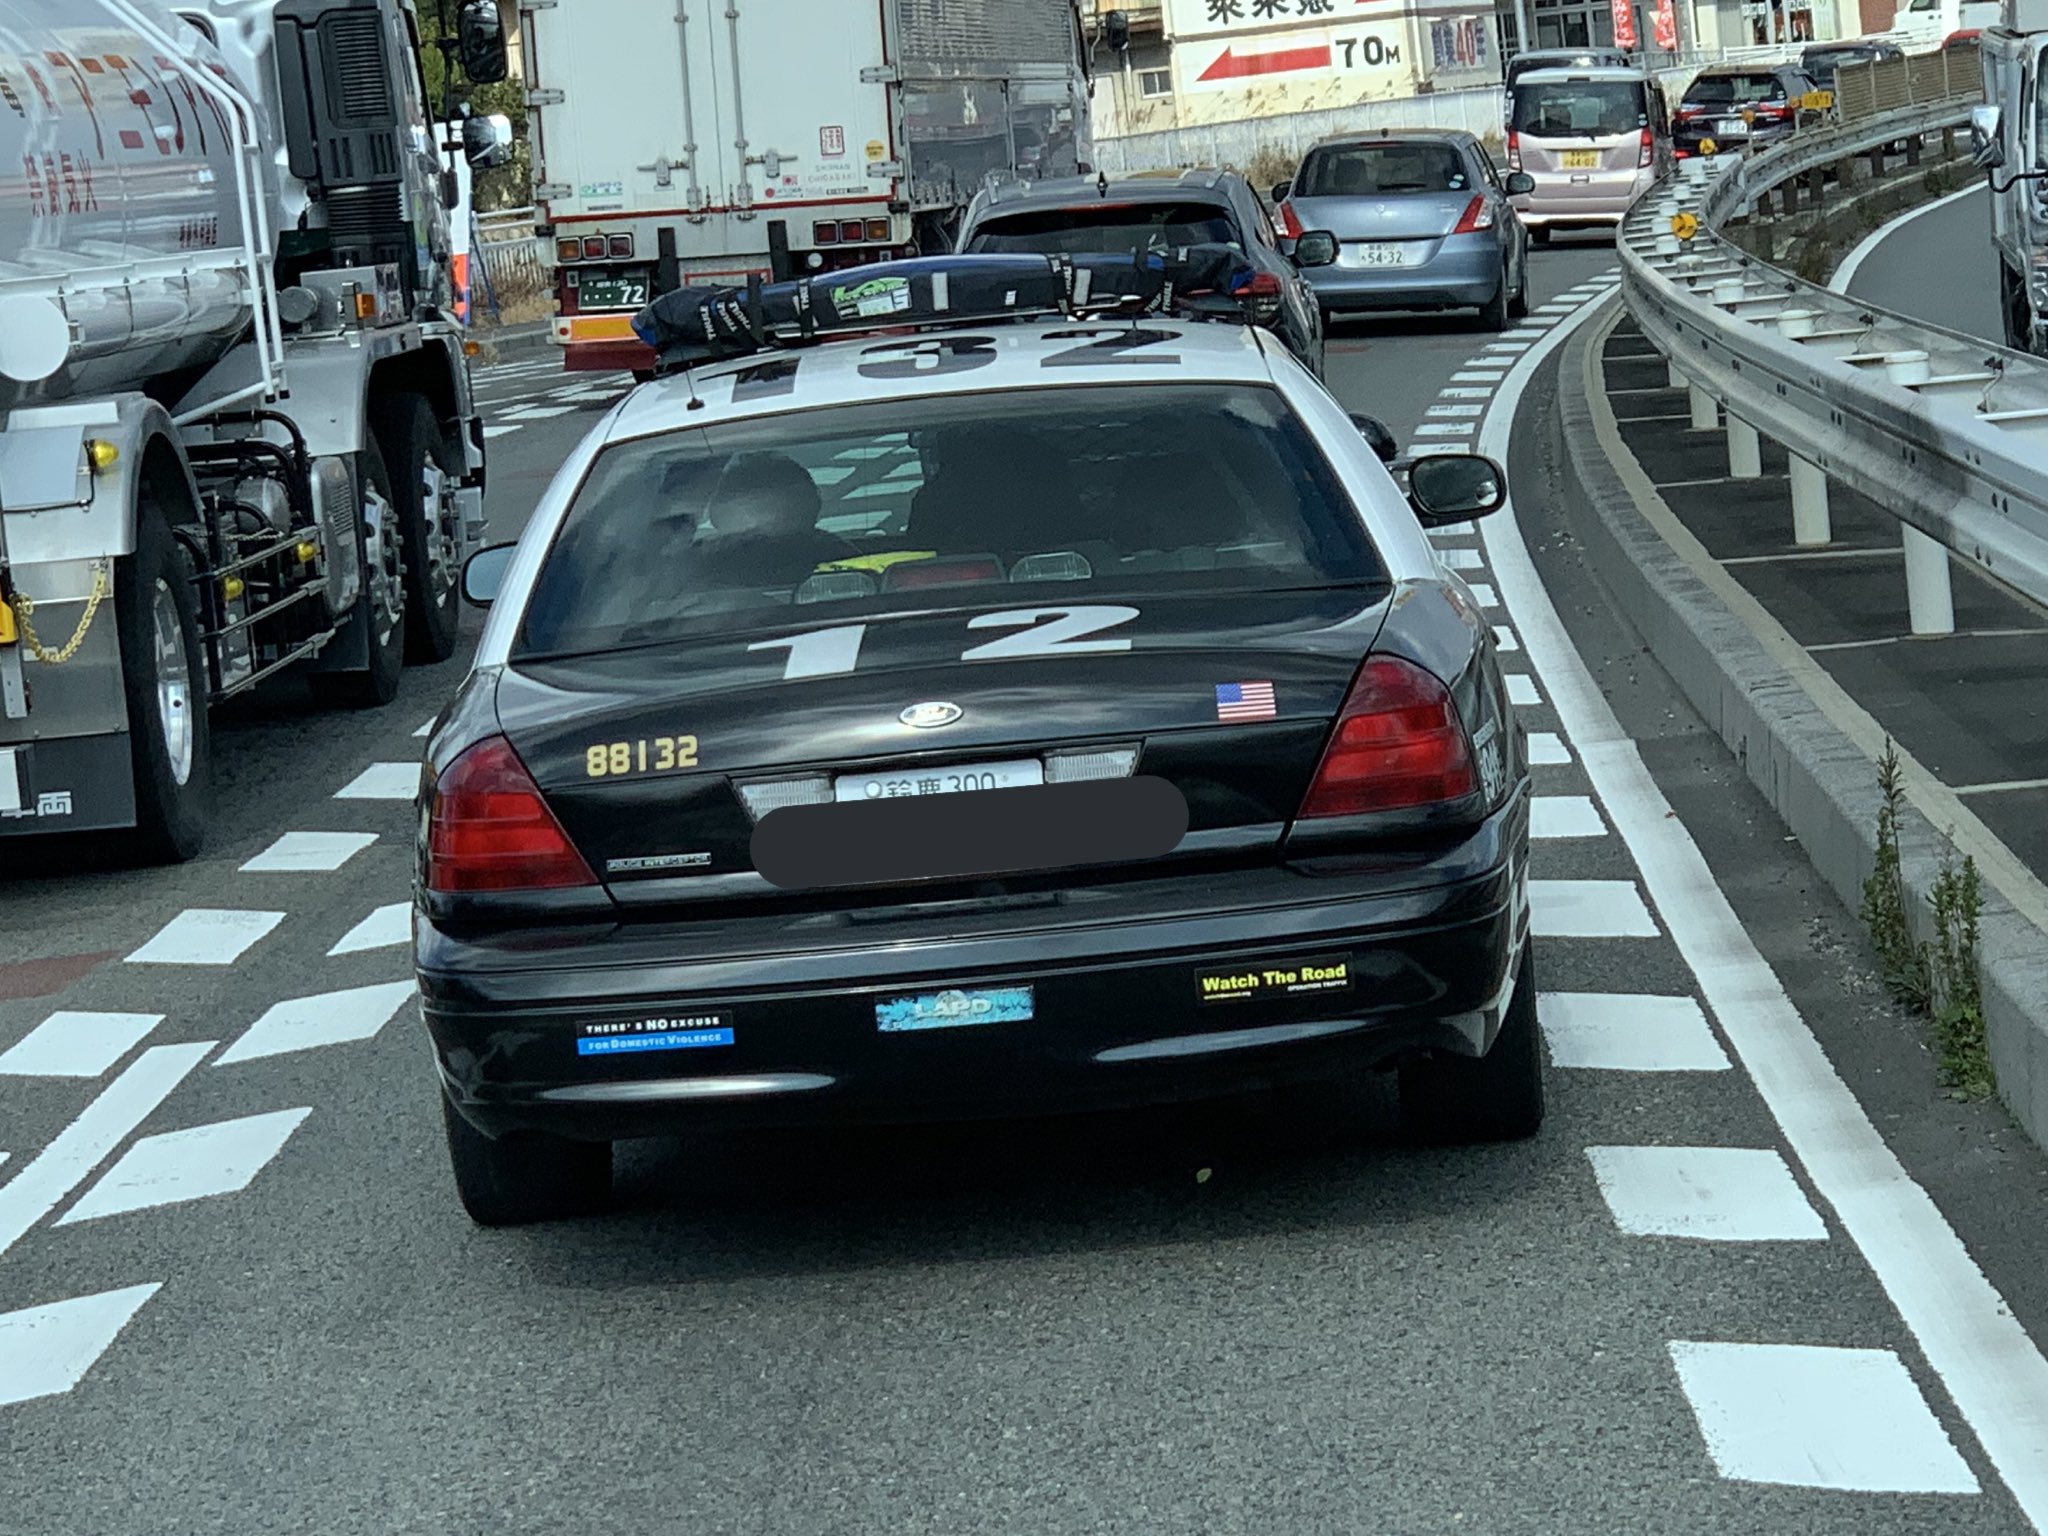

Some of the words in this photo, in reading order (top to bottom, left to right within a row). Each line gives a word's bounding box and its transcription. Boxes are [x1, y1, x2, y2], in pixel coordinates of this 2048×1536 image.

[1335, 35, 1401, 68] 70M
[620, 285, 645, 304] 72
[700, 304, 717, 340] THULE
[716, 301, 738, 332] THULE
[586, 735, 699, 777] 88132
[1202, 973, 1259, 992] Watch
[1262, 970, 1297, 986] The
[1301, 963, 1347, 982] Road
[915, 998, 993, 1018] LAPD
[646, 1018, 668, 1031] NO
[670, 1016, 721, 1029] EXCUSE
